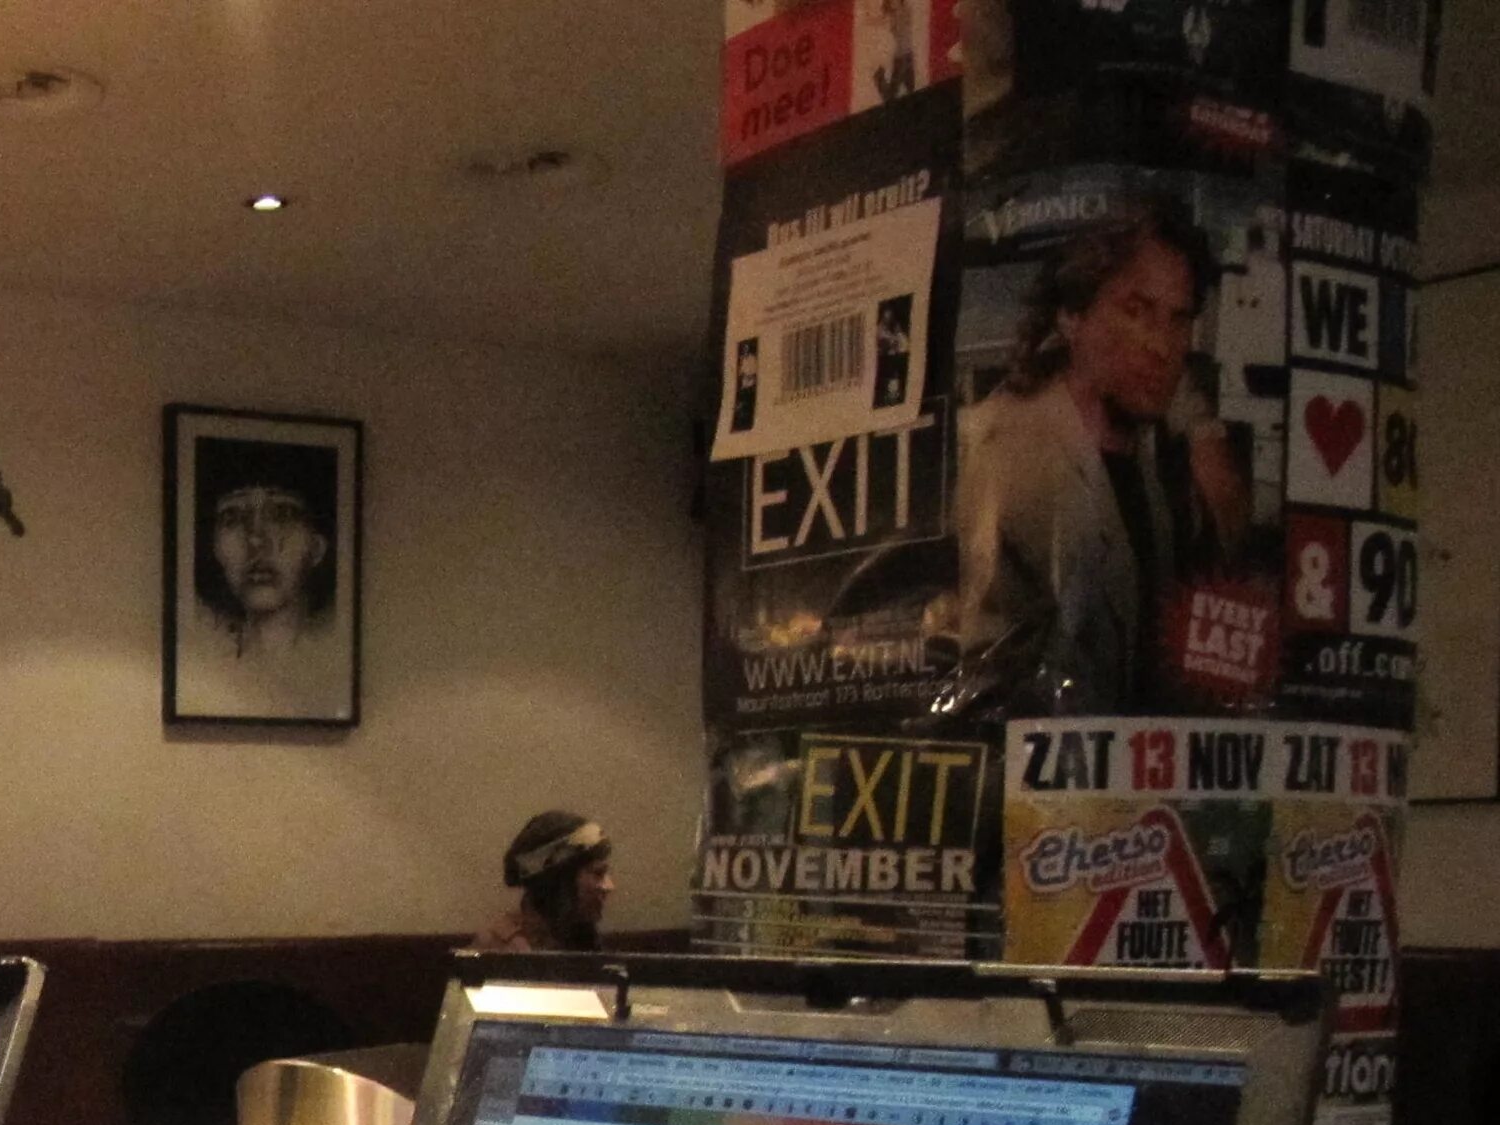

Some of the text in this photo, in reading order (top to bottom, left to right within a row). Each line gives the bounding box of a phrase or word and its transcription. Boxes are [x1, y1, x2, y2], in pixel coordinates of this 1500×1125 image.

[745, 32, 816, 93] Doe
[741, 62, 831, 141] mee!
[1300, 274, 1369, 356] WE
[750, 411, 937, 556] EXIT
[1294, 541, 1335, 620] &
[1187, 618, 1266, 667] LAST
[1192, 591, 1269, 633] EVERY
[1022, 730, 1265, 791] ZAT 13 NOV
[1285, 734, 1341, 794] ZAT
[1348, 737, 1380, 796] 13
[799, 747, 972, 846] EXIT
[702, 847, 977, 892] NOVEMBER
[1137, 889, 1172, 918] HET
[1117, 921, 1190, 960] FOUTE
